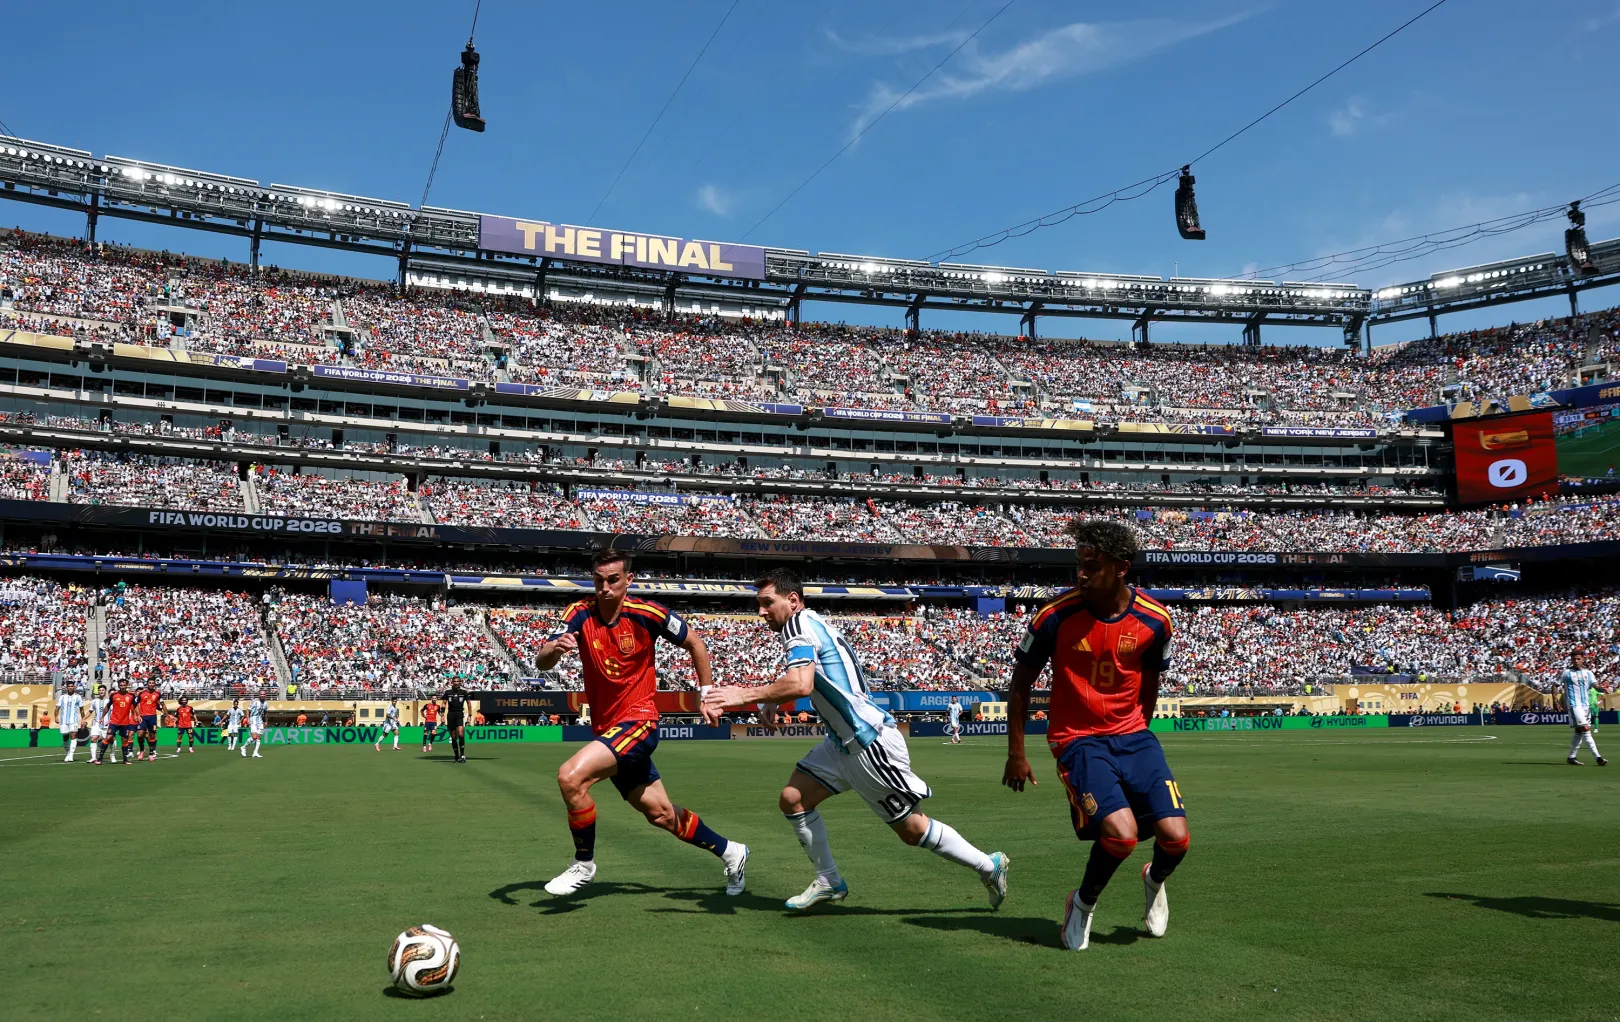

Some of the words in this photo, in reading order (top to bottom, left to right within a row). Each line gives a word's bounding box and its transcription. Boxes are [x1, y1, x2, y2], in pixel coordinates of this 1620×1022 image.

[515, 221, 601, 257] THE
[611, 233, 733, 271] FINAL
[324, 368, 341, 376] FIFA
[342, 370, 369, 378] WORLD
[370, 372, 385, 380] CUP
[386, 374, 412, 382] 2026
[414, 377, 431, 385] THE
[433, 379, 458, 387] FINAL
[578, 492, 597, 500] FIFA
[598, 492, 629, 501] WORLD
[630, 494, 648, 502] CUP
[150, 512, 185, 525] FIFA
[189, 514, 249, 528] WORLD
[252, 518, 283, 530] CUP
[286, 520, 342, 533] 2026
[349, 522, 384, 535] THE
[387, 525, 440, 539] FINAL
[1146, 553, 1169, 562] FIFA
[1171, 553, 1212, 563] WORLD
[1214, 554, 1235, 563] CUP
[1238, 554, 1276, 563] 2026
[1281, 554, 1306, 563] THE
[637, 582, 681, 590] THE
[684, 584, 755, 592] FINAL
[1091, 660, 1114, 687] 19
[1401, 692, 1418, 700] FIFA
[1327, 718, 1366, 726] HYUNDAI
[1427, 716, 1467, 724] HYUNDAI
[1541, 714, 1569, 722] HYUN
[466, 729, 523, 739] YUNDAI
[660, 727, 693, 738] NDAI
[747, 727, 777, 737] NEW
[780, 726, 813, 736] YORK
[967, 724, 1007, 734] HYUND
[877, 794, 905, 817] 10
